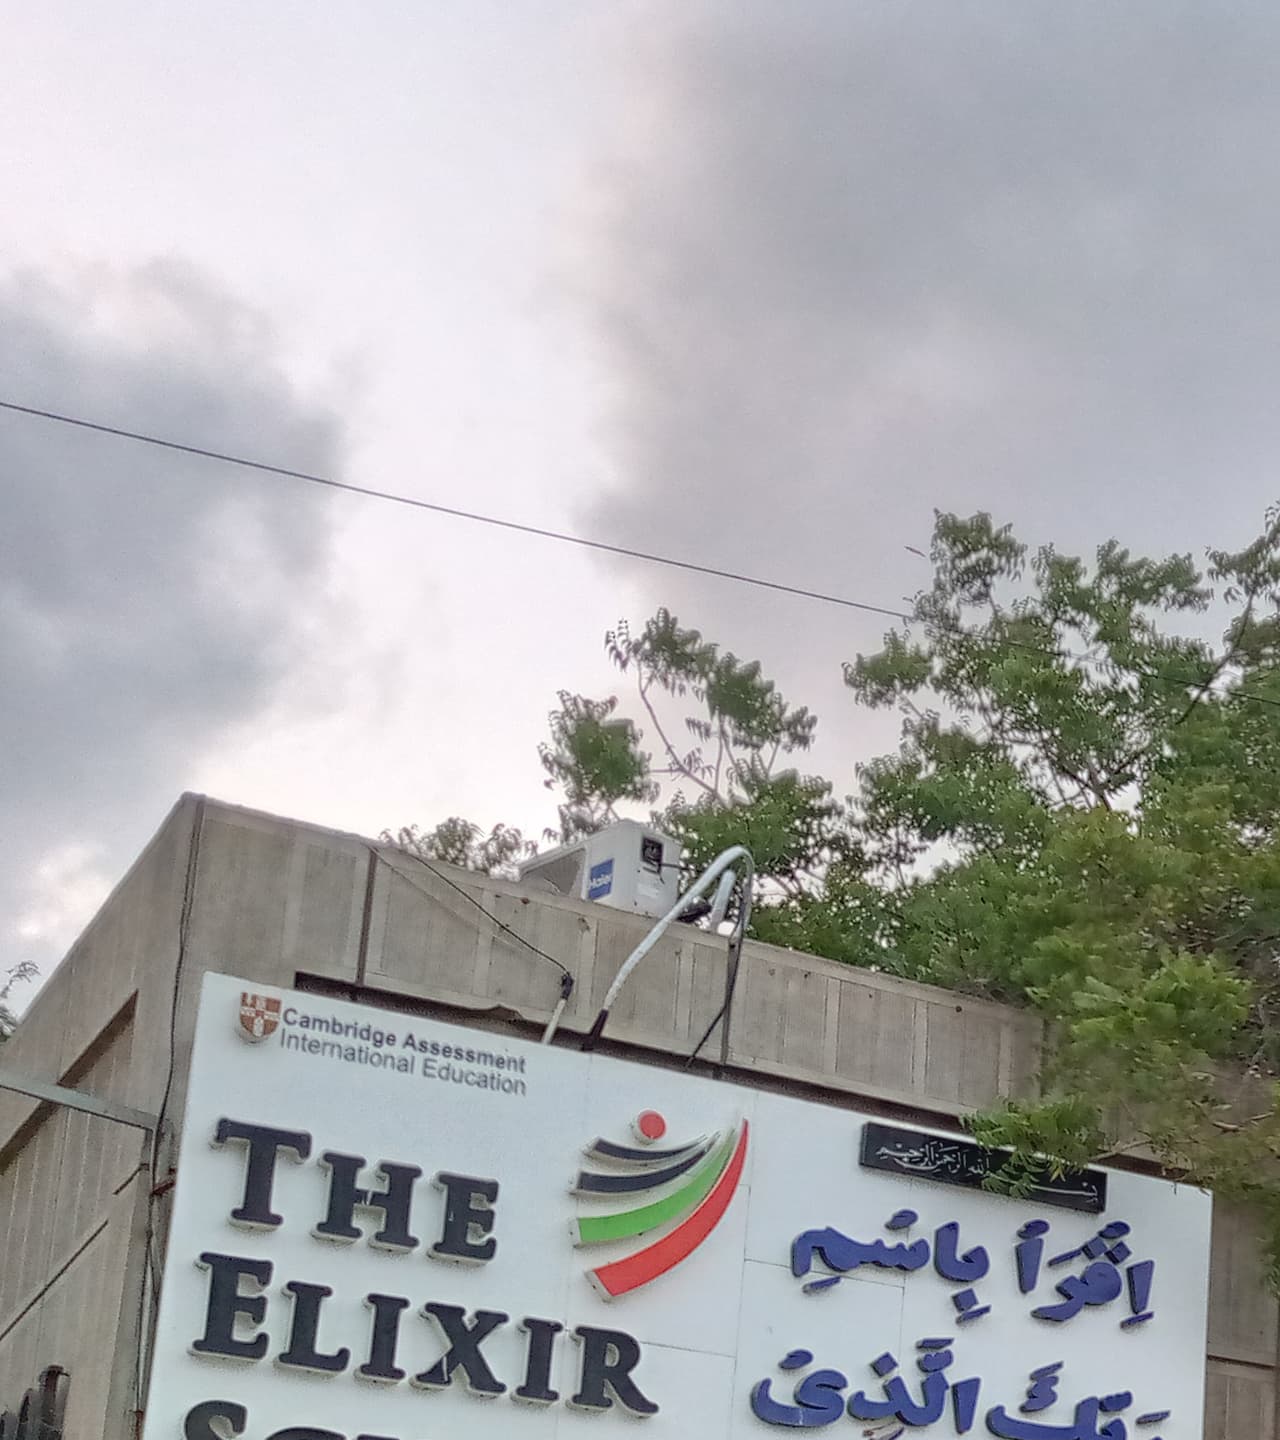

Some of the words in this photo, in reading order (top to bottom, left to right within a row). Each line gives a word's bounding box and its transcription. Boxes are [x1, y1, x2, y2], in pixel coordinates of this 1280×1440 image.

[280, 1028, 415, 1074] International
[422, 1058, 527, 1096] Education
[282, 1008, 397, 1048] Cambridge
[402, 1034, 527, 1074] Assessment
[212, 1117, 500, 1263] THE
[189, 1251, 660, 1417] ELIXIR
